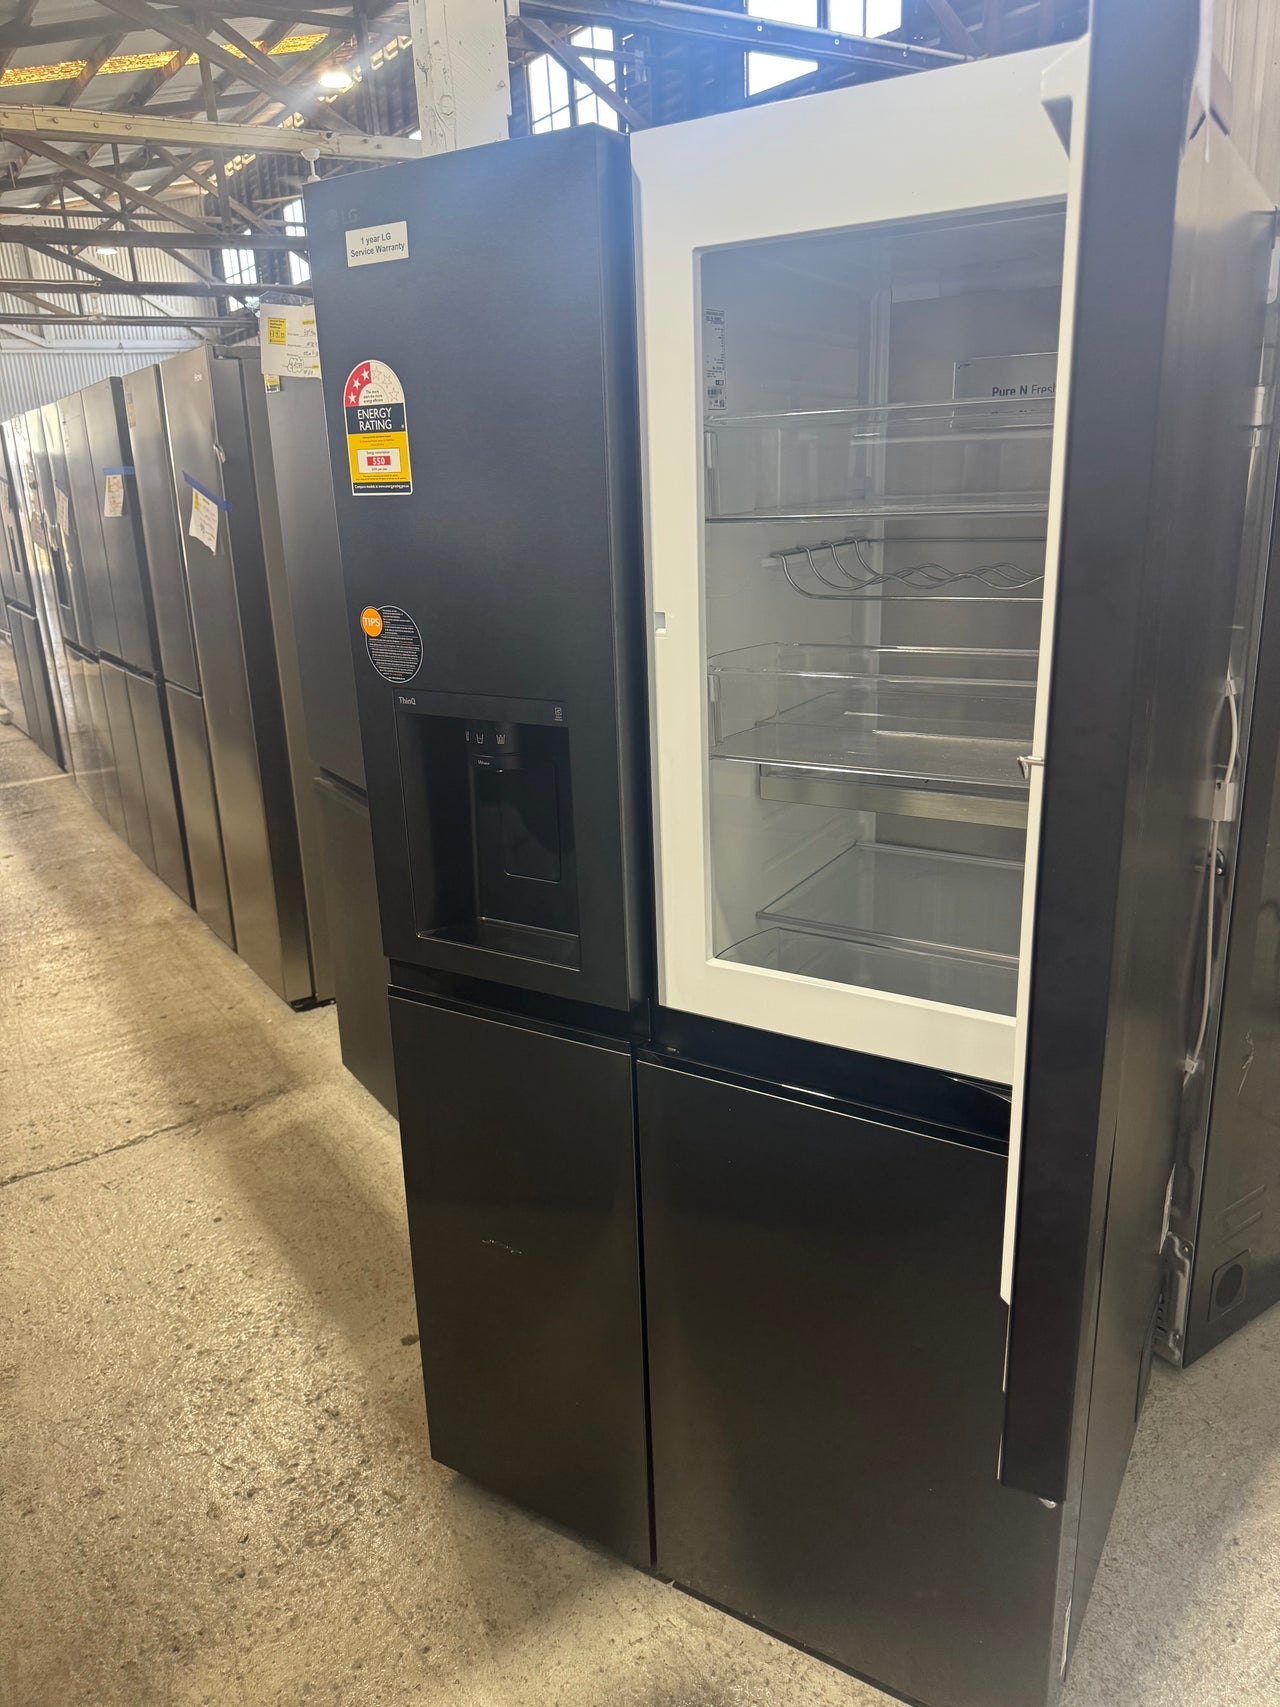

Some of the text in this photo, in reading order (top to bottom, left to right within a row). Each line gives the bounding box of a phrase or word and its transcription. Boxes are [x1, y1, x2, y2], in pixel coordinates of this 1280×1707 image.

[366, 236, 380, 245] year
[382, 232, 391, 240] LG
[351, 242, 405, 257] Service Warranty
[992, 386, 1016, 397] Pure
[1020, 385, 1028, 395] N
[357, 407, 392, 420] ENERGY
[359, 419, 392, 431] RATING
[372, 457, 386, 466] 550
[363, 617, 381, 627] TIPS
[399, 697, 416, 705] ThinQ
